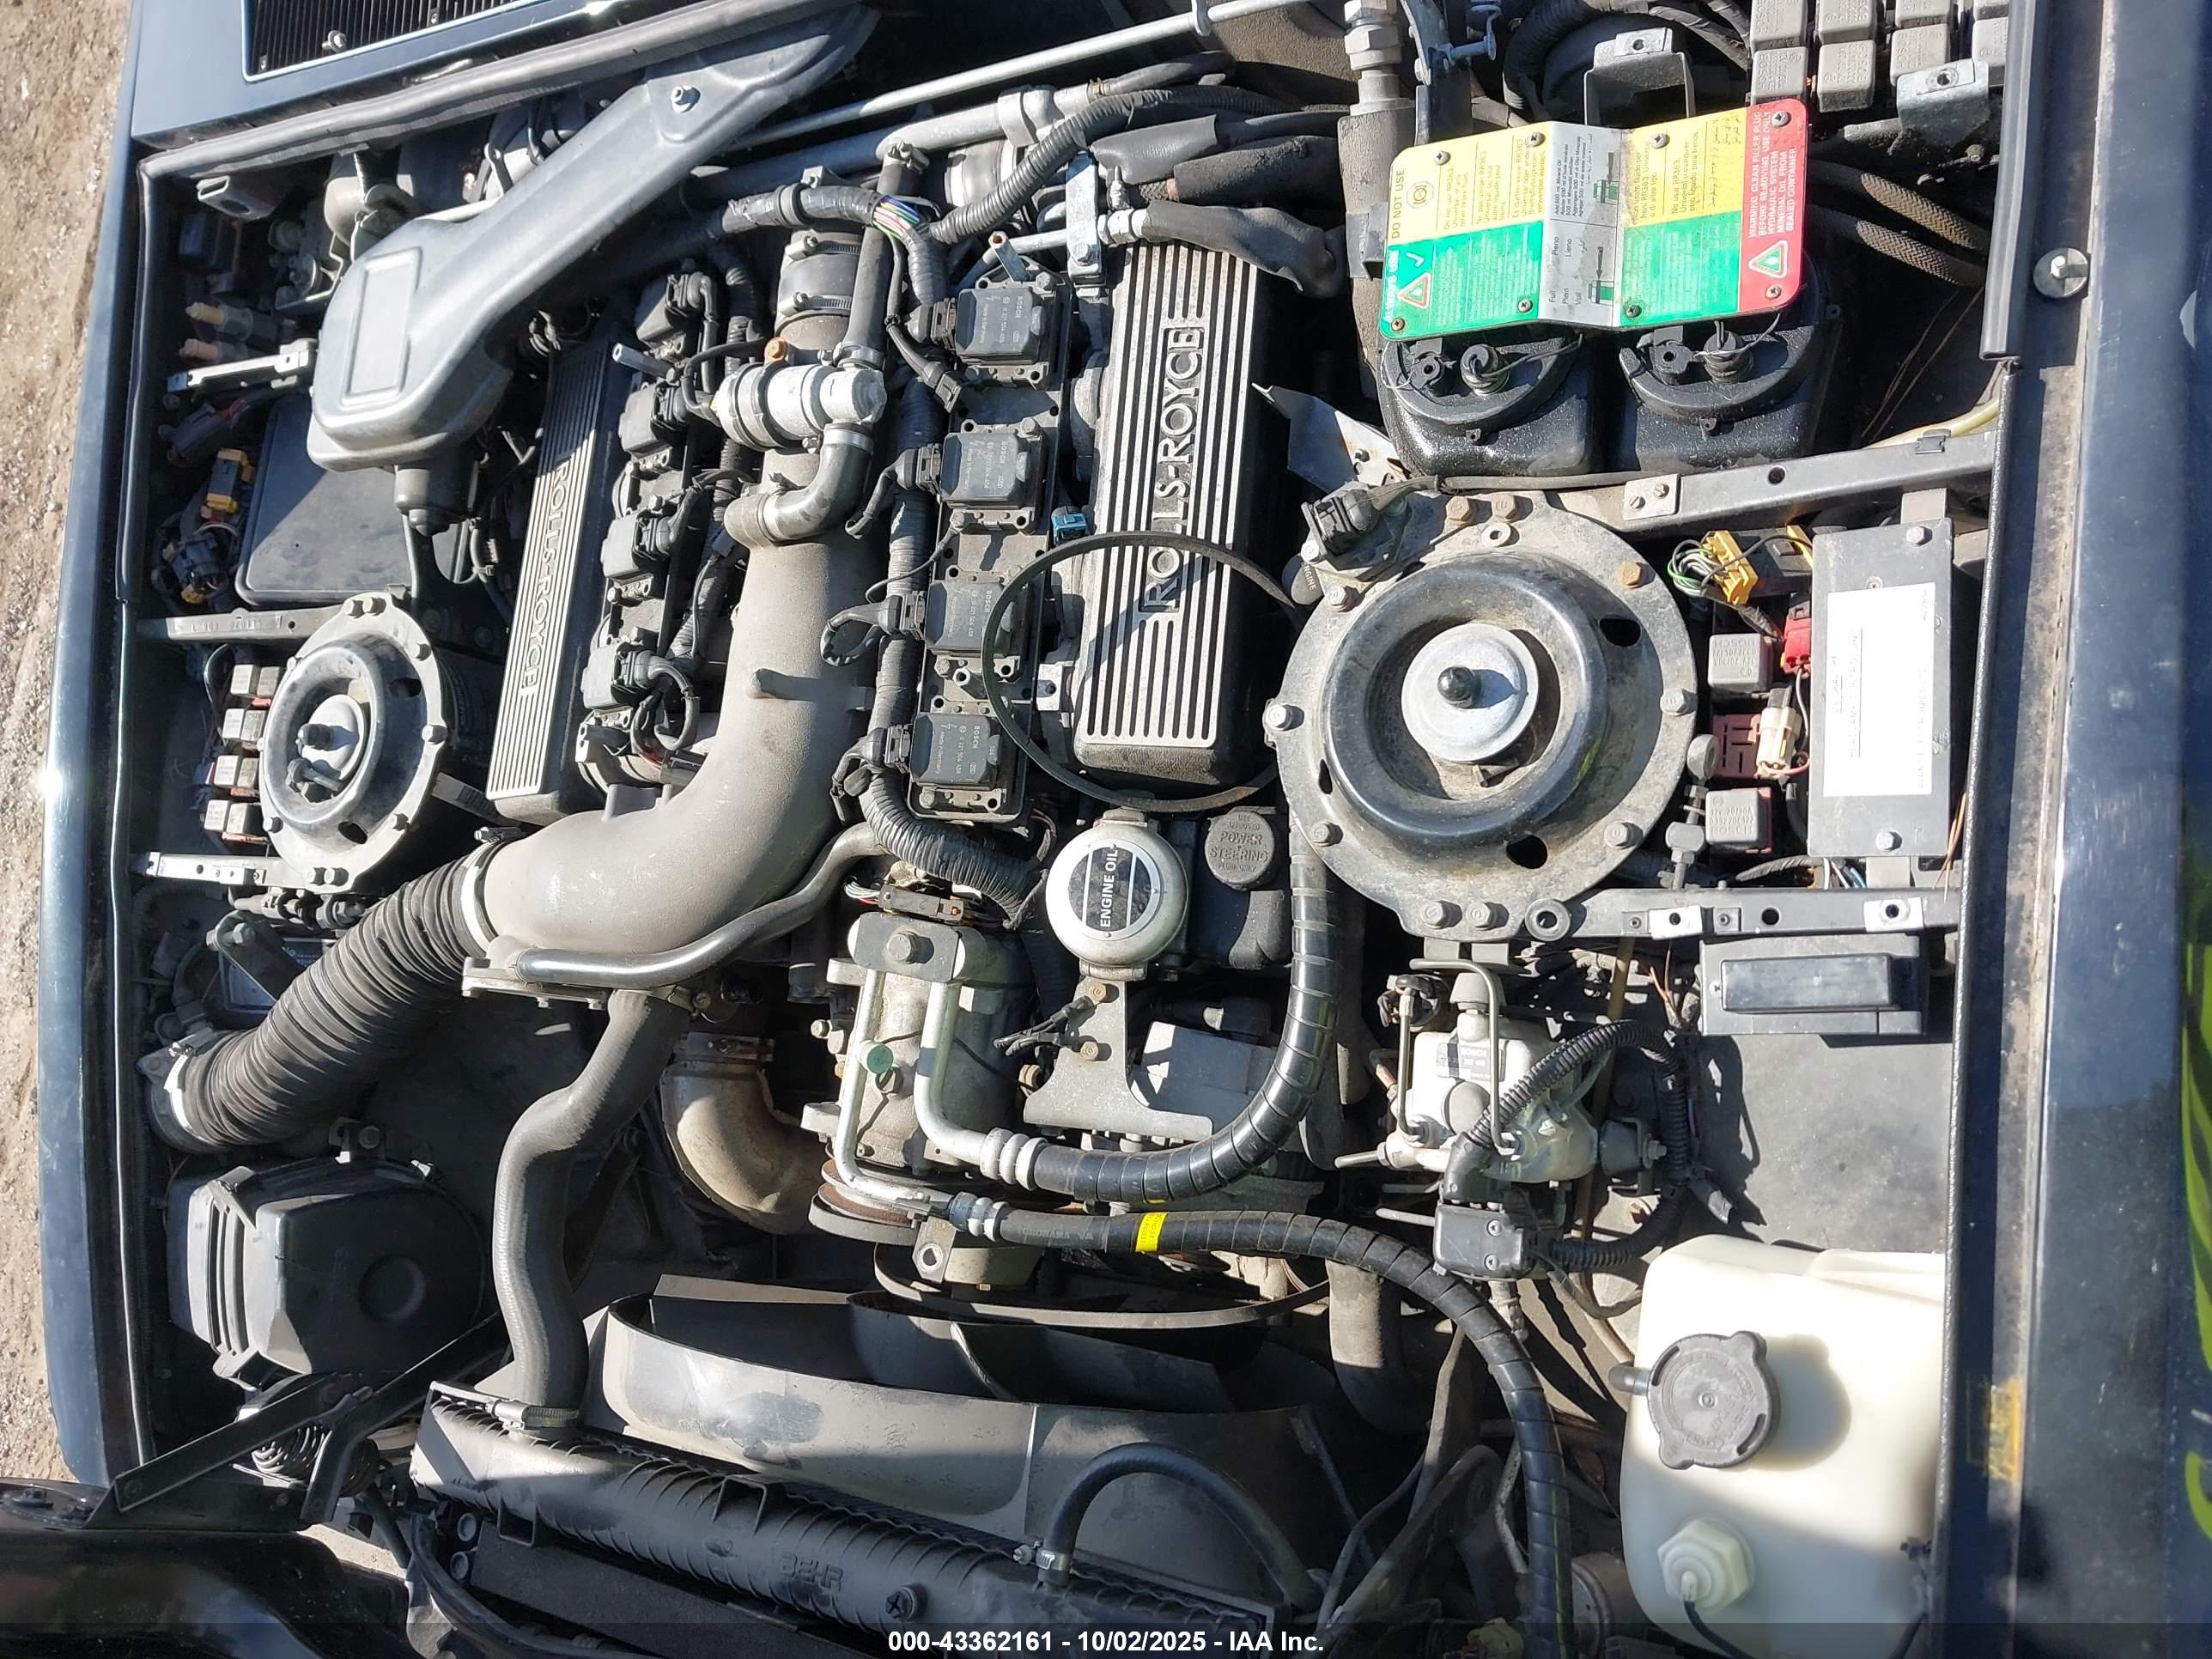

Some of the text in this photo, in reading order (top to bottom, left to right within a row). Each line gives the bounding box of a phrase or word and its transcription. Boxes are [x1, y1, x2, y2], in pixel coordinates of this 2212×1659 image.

[1751, 111, 1762, 192] CLEAN FILLER PLUG
[1759, 203, 1767, 235] BEFORE
[1763, 111, 1771, 133] ONLY
[1778, 177, 1787, 192] OIL
[1392, 168, 1405, 238] DO NOT USE
[1671, 204, 1679, 213] No
[1767, 150, 1778, 234] HYDRAULIC SYSTEM
[1777, 195, 1786, 233] MINERAL
[1785, 198, 1795, 231] SEALED
[1564, 238, 1572, 257] Lleno
[1548, 236, 1559, 302] Full Pieno
[1015, 295, 1024, 318] BOSCH
[1144, 328, 1202, 610] ROLS-ROYCE
[984, 589, 993, 612] BOSCH
[972, 725, 981, 749] BOSCH
[1219, 830, 1263, 846] POWER
[1209, 846, 1270, 864] STEERING
[1100, 848, 1118, 927] ENGINE OIL
